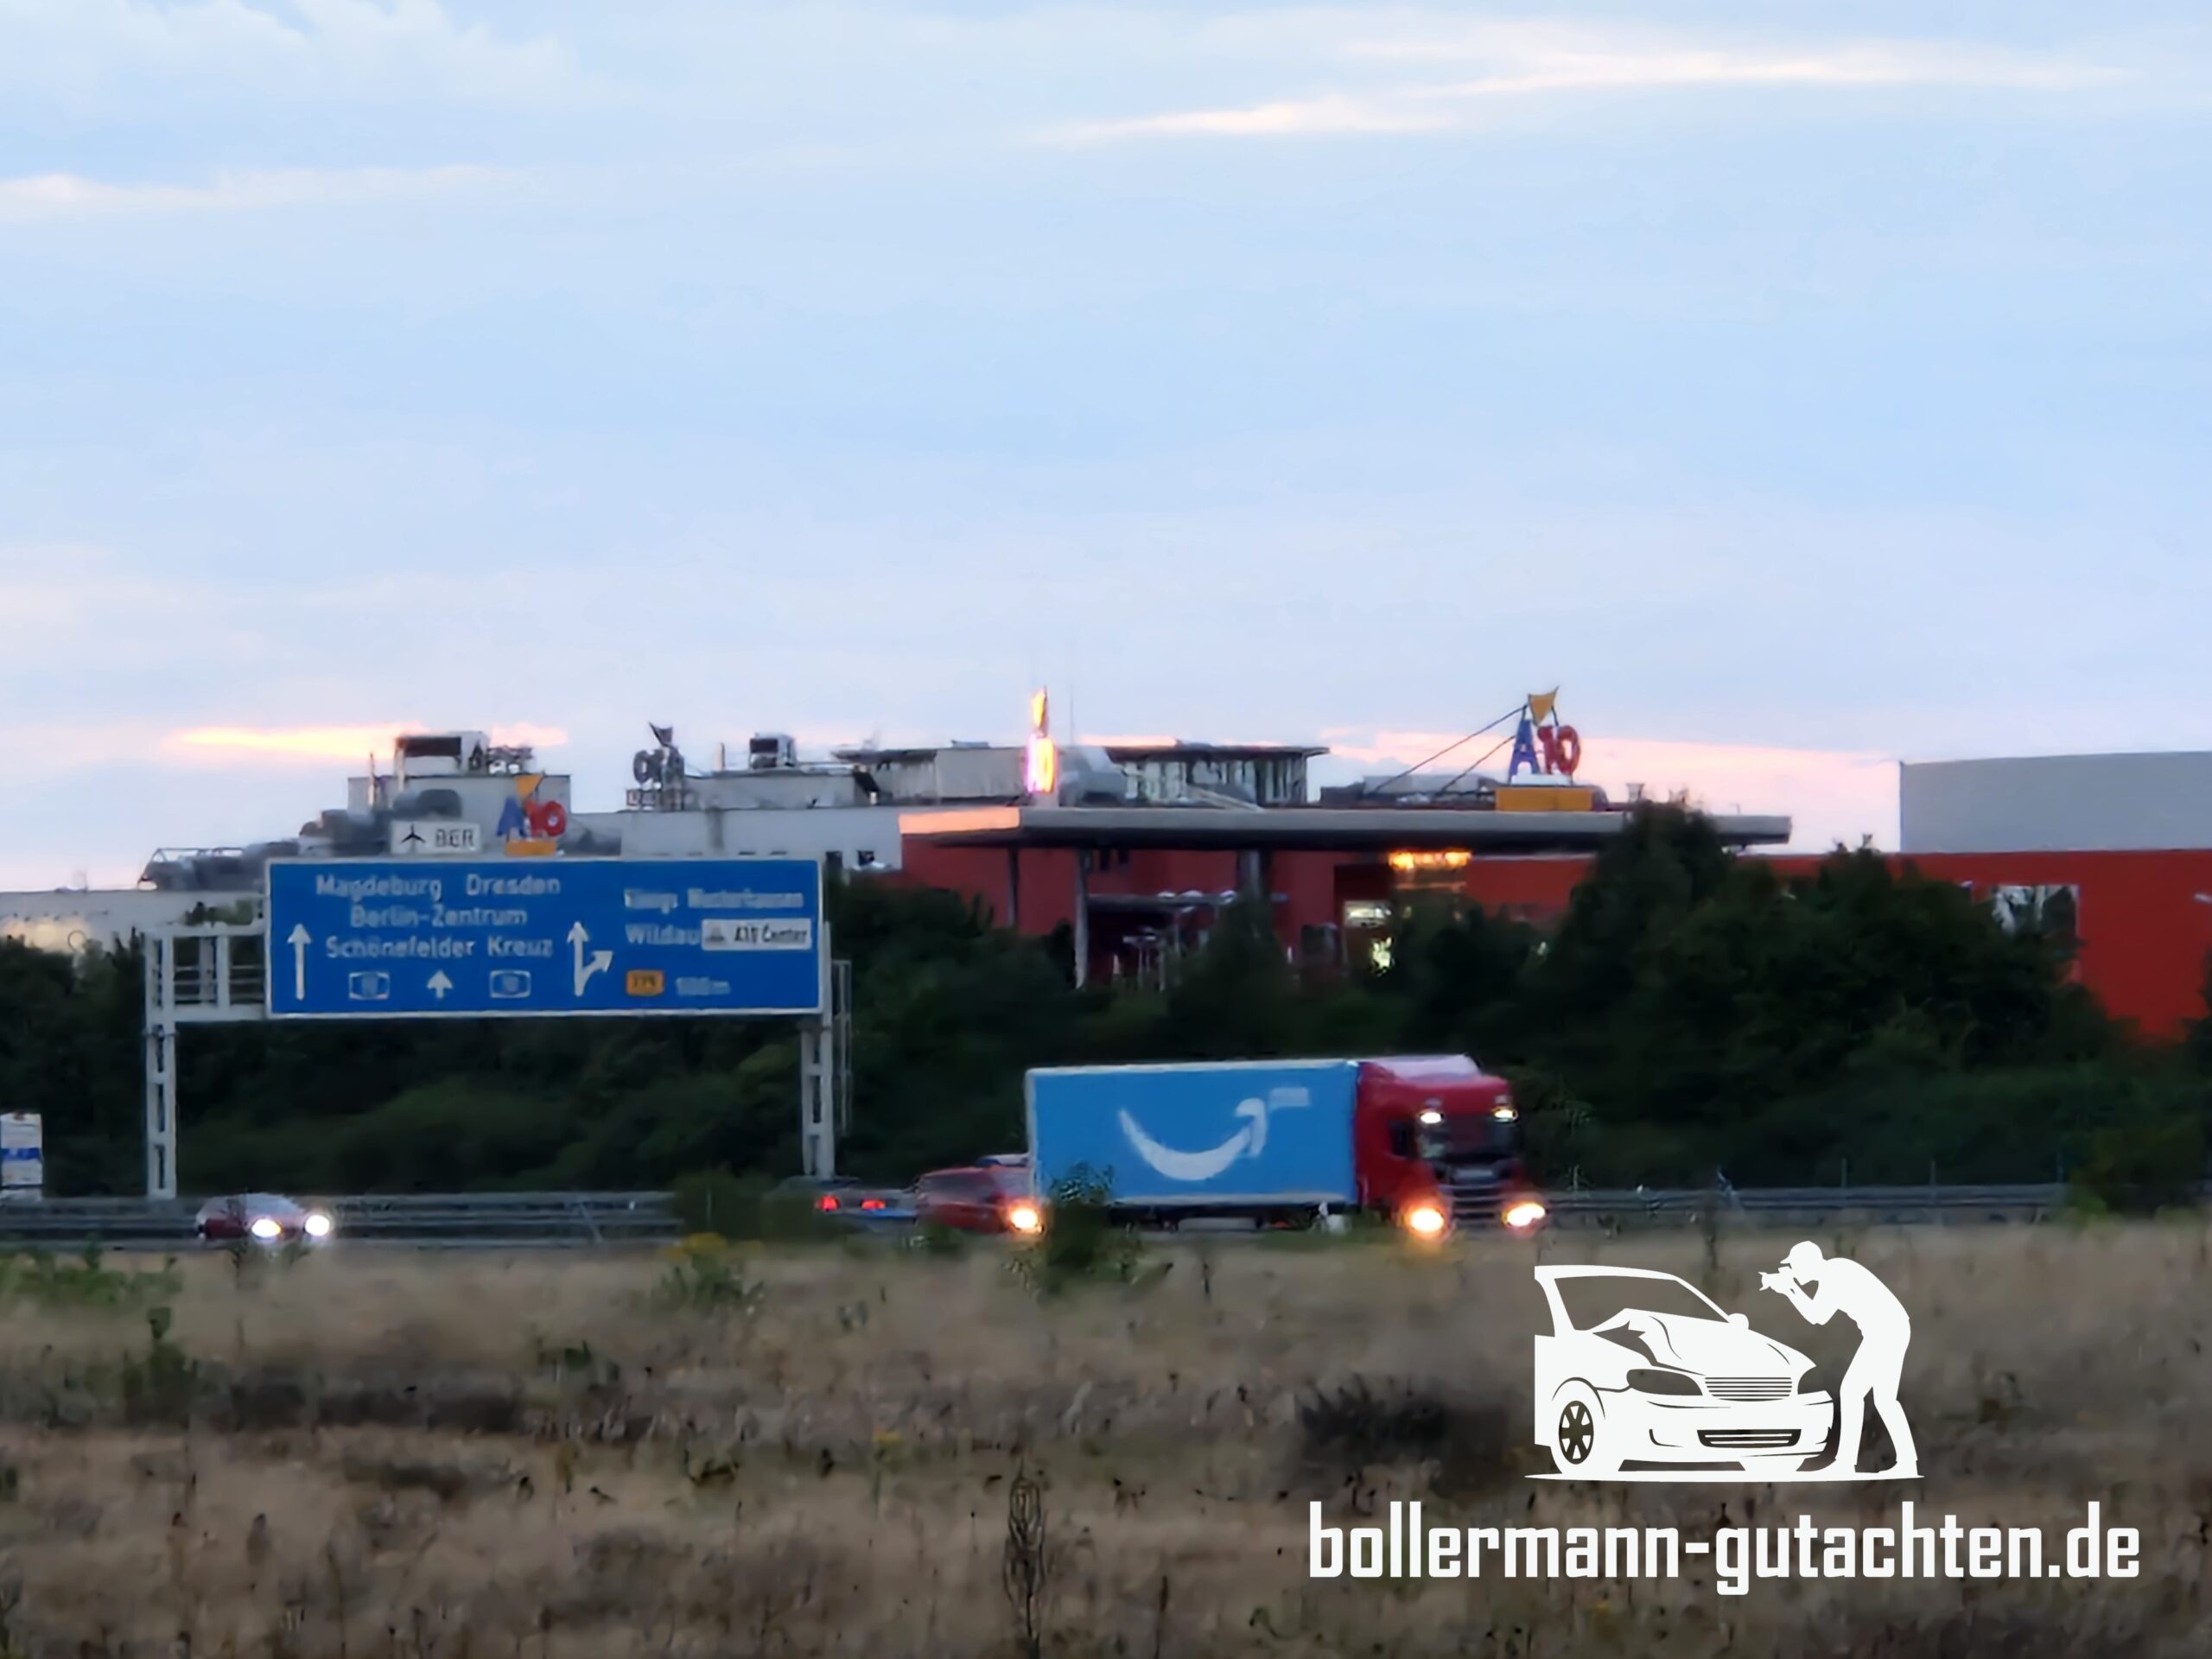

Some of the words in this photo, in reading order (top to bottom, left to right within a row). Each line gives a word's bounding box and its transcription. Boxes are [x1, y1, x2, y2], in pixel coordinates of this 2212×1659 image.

[435, 827, 475, 848] BER
[315, 874, 442, 901] Magdeburg
[466, 873, 561, 895] Dresden
[349, 904, 527, 927] Berlin-Zentrum
[326, 935, 475, 958] Schönefelder
[487, 936, 554, 957] Kreuz
